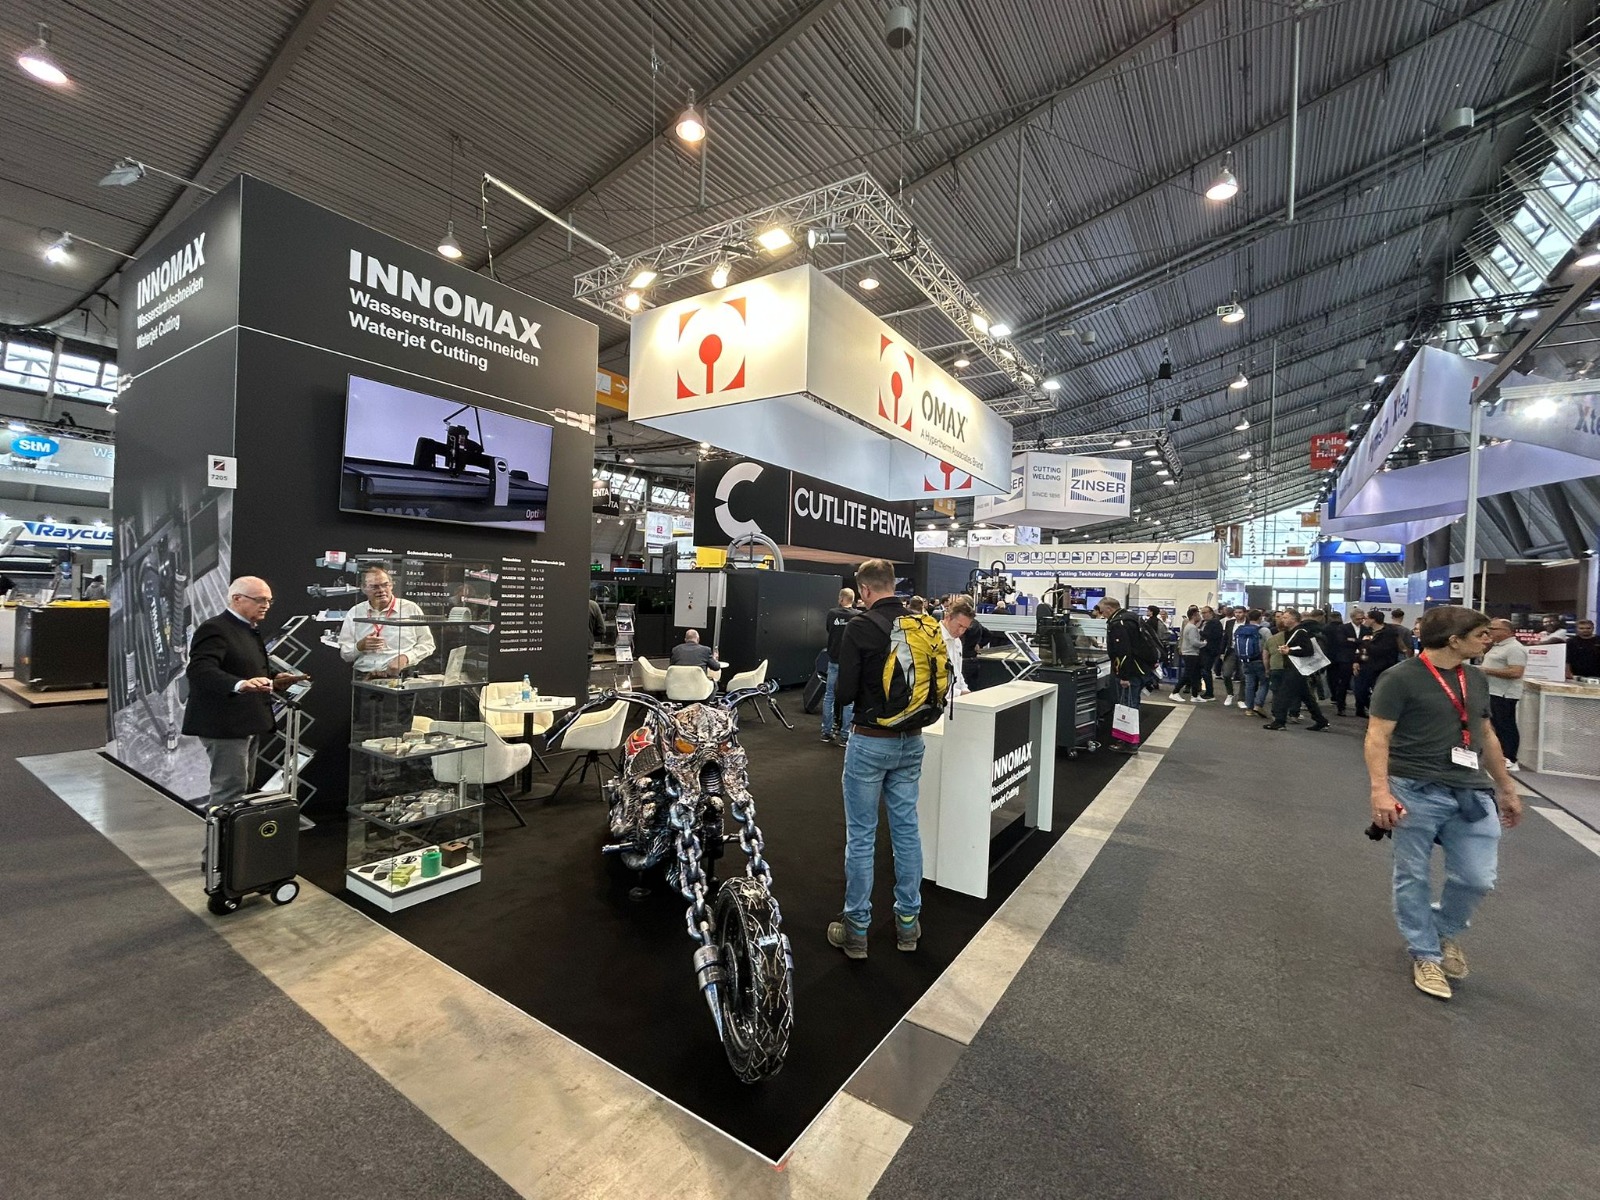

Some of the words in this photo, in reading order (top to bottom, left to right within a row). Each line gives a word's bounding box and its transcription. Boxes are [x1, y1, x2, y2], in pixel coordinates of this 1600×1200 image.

[137, 232, 206, 310] INNOMAX
[137, 276, 204, 329] Wasserstrahlschneiden
[349, 249, 542, 349] INNOMAX
[136, 327, 158, 350] Waterjet
[158, 313, 181, 337] Cutting
[348, 310, 426, 350] Waterjet
[430, 338, 488, 372] Cutting
[349, 287, 539, 366] Wasserstrahlschneiden
[921, 390, 966, 443] OMAX
[19, 439, 51, 453] StM
[1316, 437, 1344, 446] Halle
[1032, 465, 1062, 474] CUTTING
[1032, 473, 1062, 482] WELDING
[1070, 479, 1126, 493] ZINSER
[35, 524, 115, 541] Raycus
[794, 487, 866, 531] CUTLITE
[870, 507, 913, 540] PENTA
